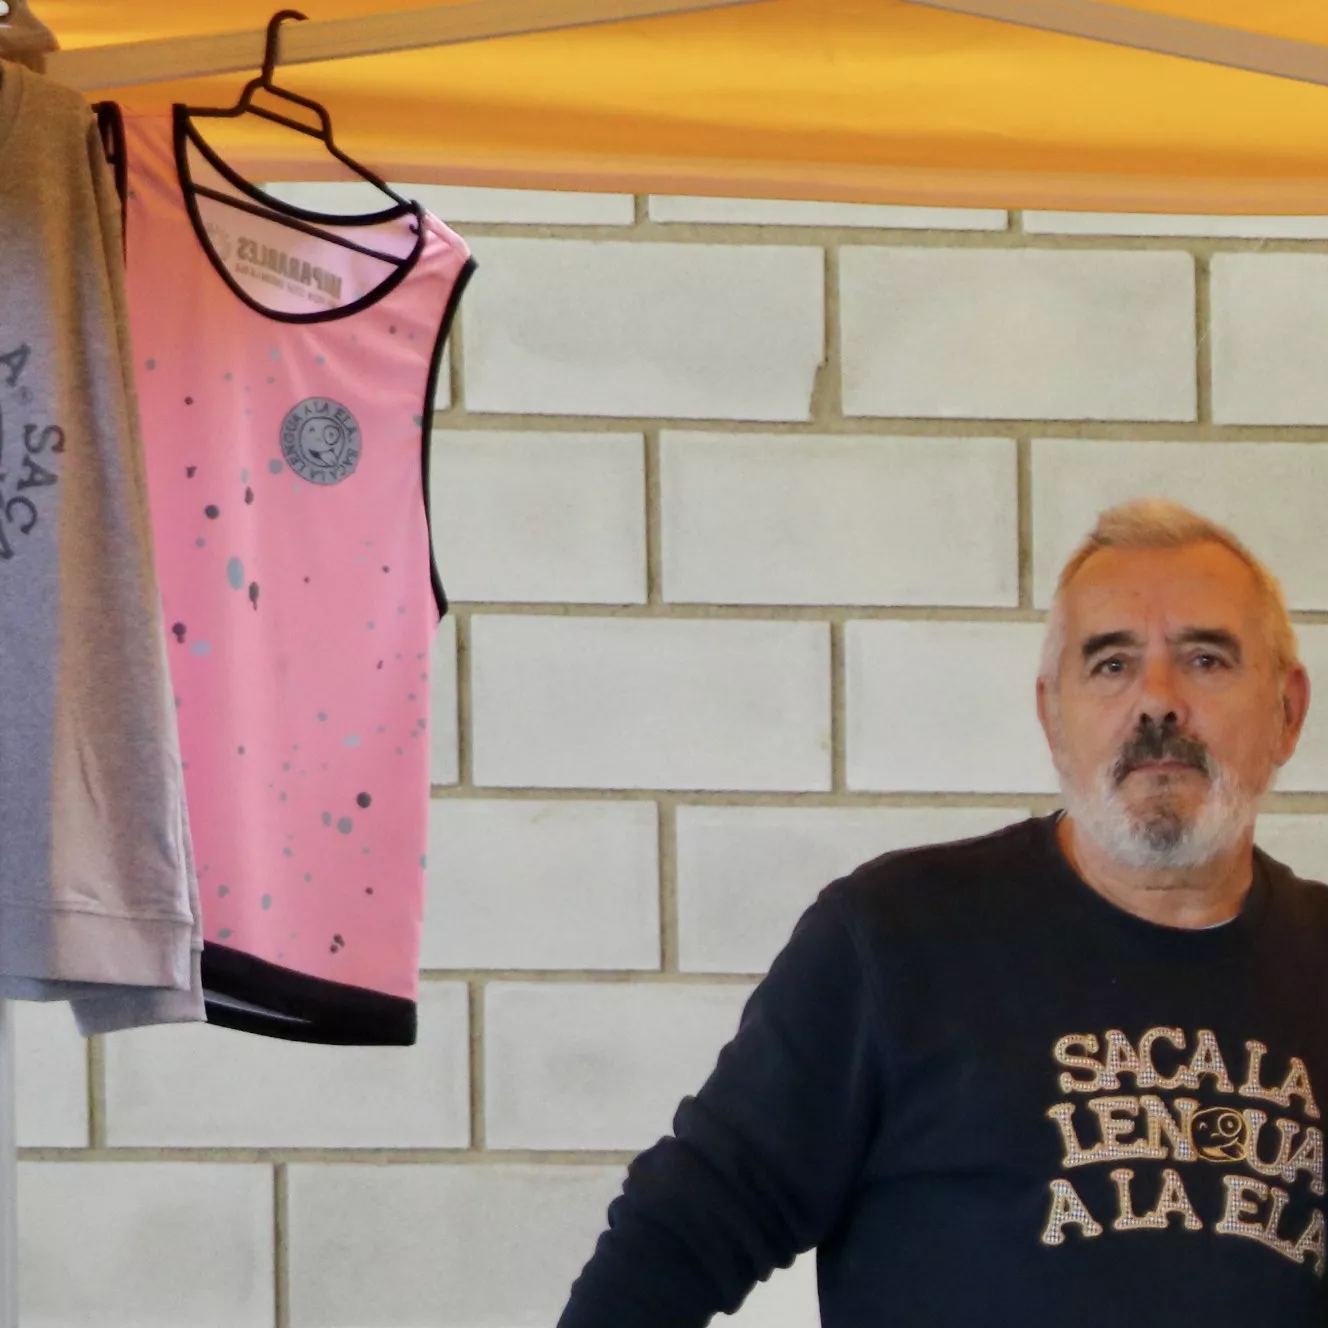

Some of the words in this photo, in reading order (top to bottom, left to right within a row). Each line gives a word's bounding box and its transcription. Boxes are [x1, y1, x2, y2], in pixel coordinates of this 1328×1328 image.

[1054, 1026, 1234, 1094] SACA
[1239, 1039, 1321, 1119] LA
[1041, 1178, 1103, 1246] A
[1110, 1168, 1204, 1231] LA
[1216, 1174, 1327, 1278] ELA
